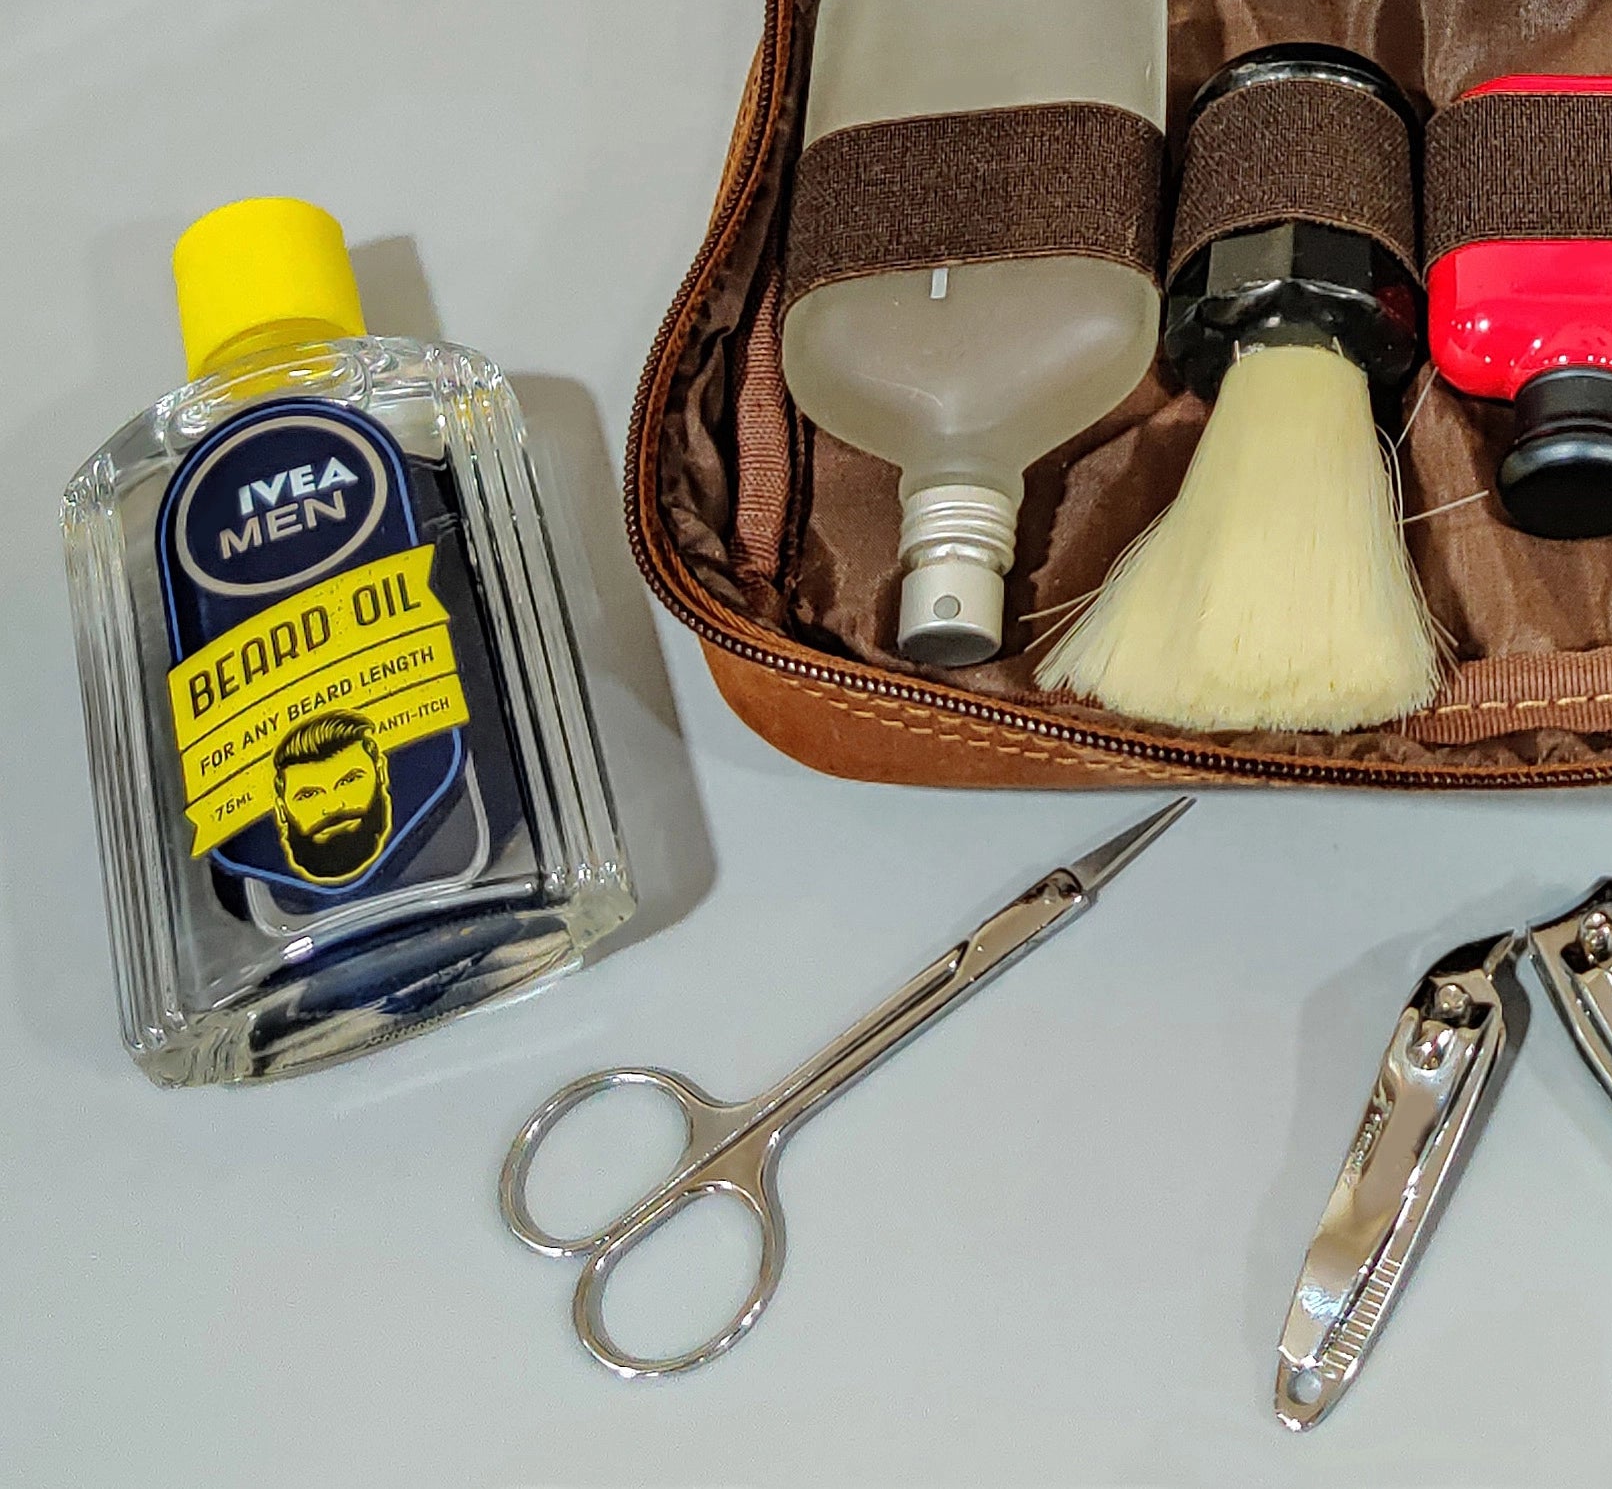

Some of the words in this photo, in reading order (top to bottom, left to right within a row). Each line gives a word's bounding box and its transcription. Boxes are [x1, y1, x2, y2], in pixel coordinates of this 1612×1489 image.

[238, 457, 359, 516] IVEA
[218, 490, 346, 560] MEN
[188, 604, 331, 719] BEARD
[352, 571, 421, 626] OIL
[199, 742, 234, 776] FOR
[241, 713, 280, 756] ANY
[287, 682, 353, 722] BEARD
[360, 646, 435, 687] LENGTH
[377, 696, 450, 734] ANTI-ITCH
